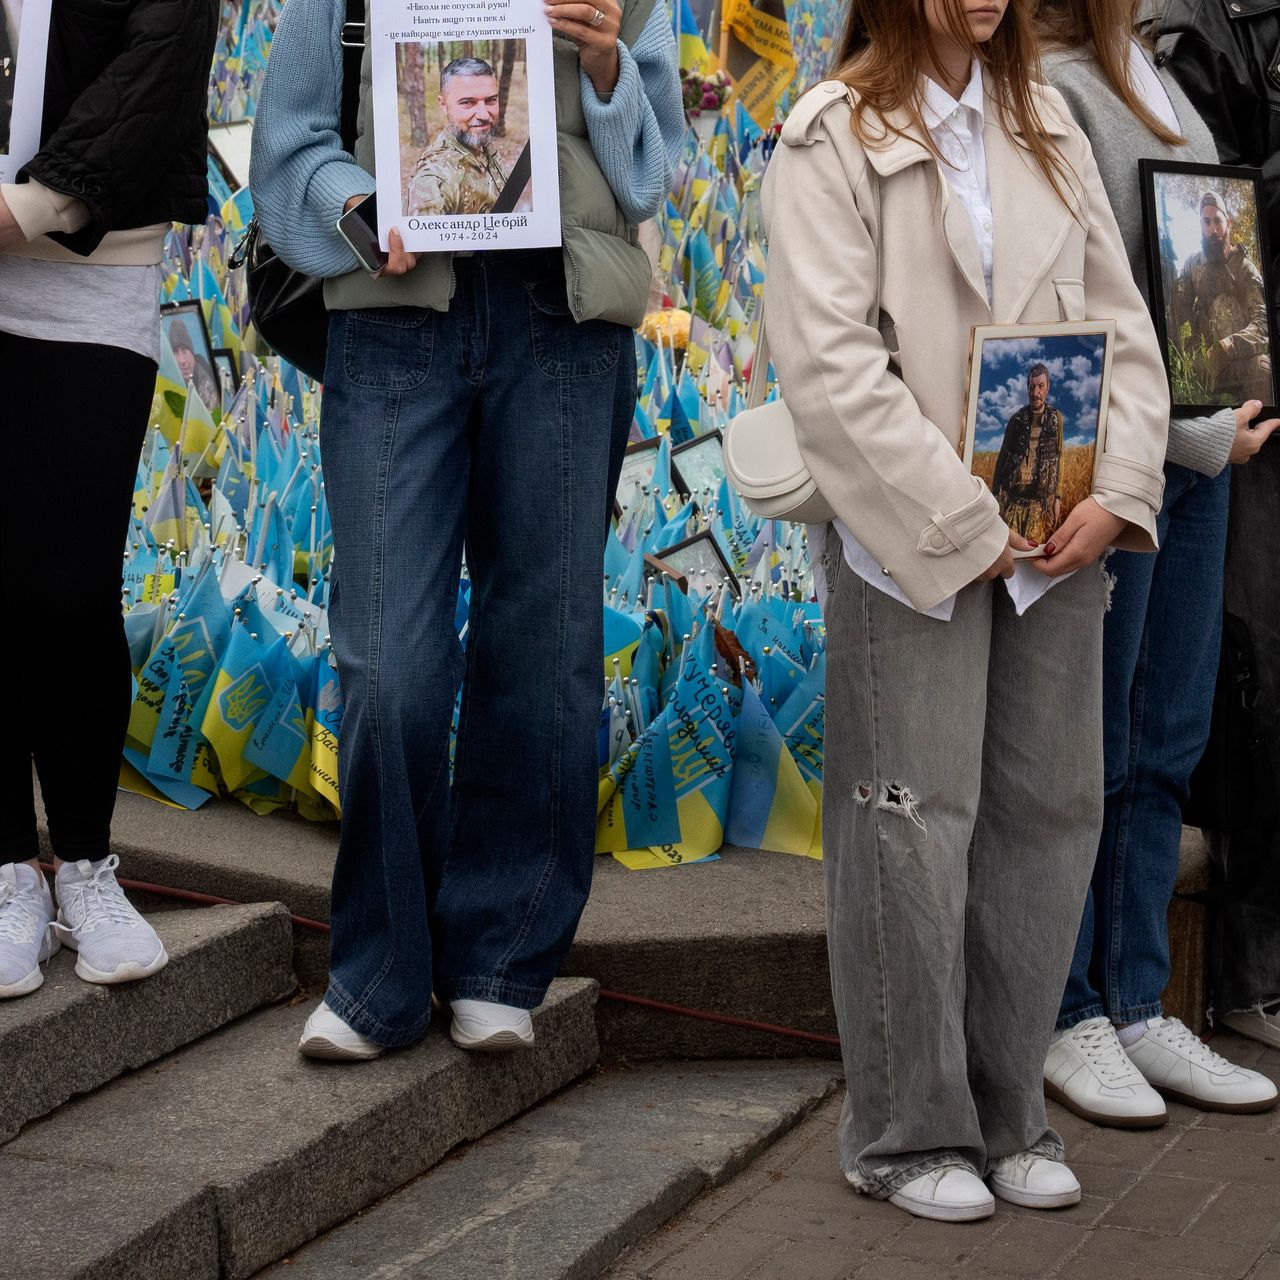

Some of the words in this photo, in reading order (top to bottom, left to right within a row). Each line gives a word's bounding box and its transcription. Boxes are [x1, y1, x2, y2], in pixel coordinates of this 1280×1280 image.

[406, 1, 439, 11] «Ніколи
[451, 2, 486, 11] опускай
[487, 0, 511, 11] руки!
[413, 15, 440, 24] Навіть
[441, 15, 464, 24] якщо
[465, 15, 475, 23] ти
[483, 14, 506, 23] пеклі
[389, 30, 400, 39] це
[401, 29, 442, 39] найкраще
[443, 28, 465, 38] місце
[466, 28, 501, 37] глушити
[408, 218, 481, 231] Олександр
[483, 216, 528, 231] Цебрій
[439, 231, 499, 242] 1974-2024
